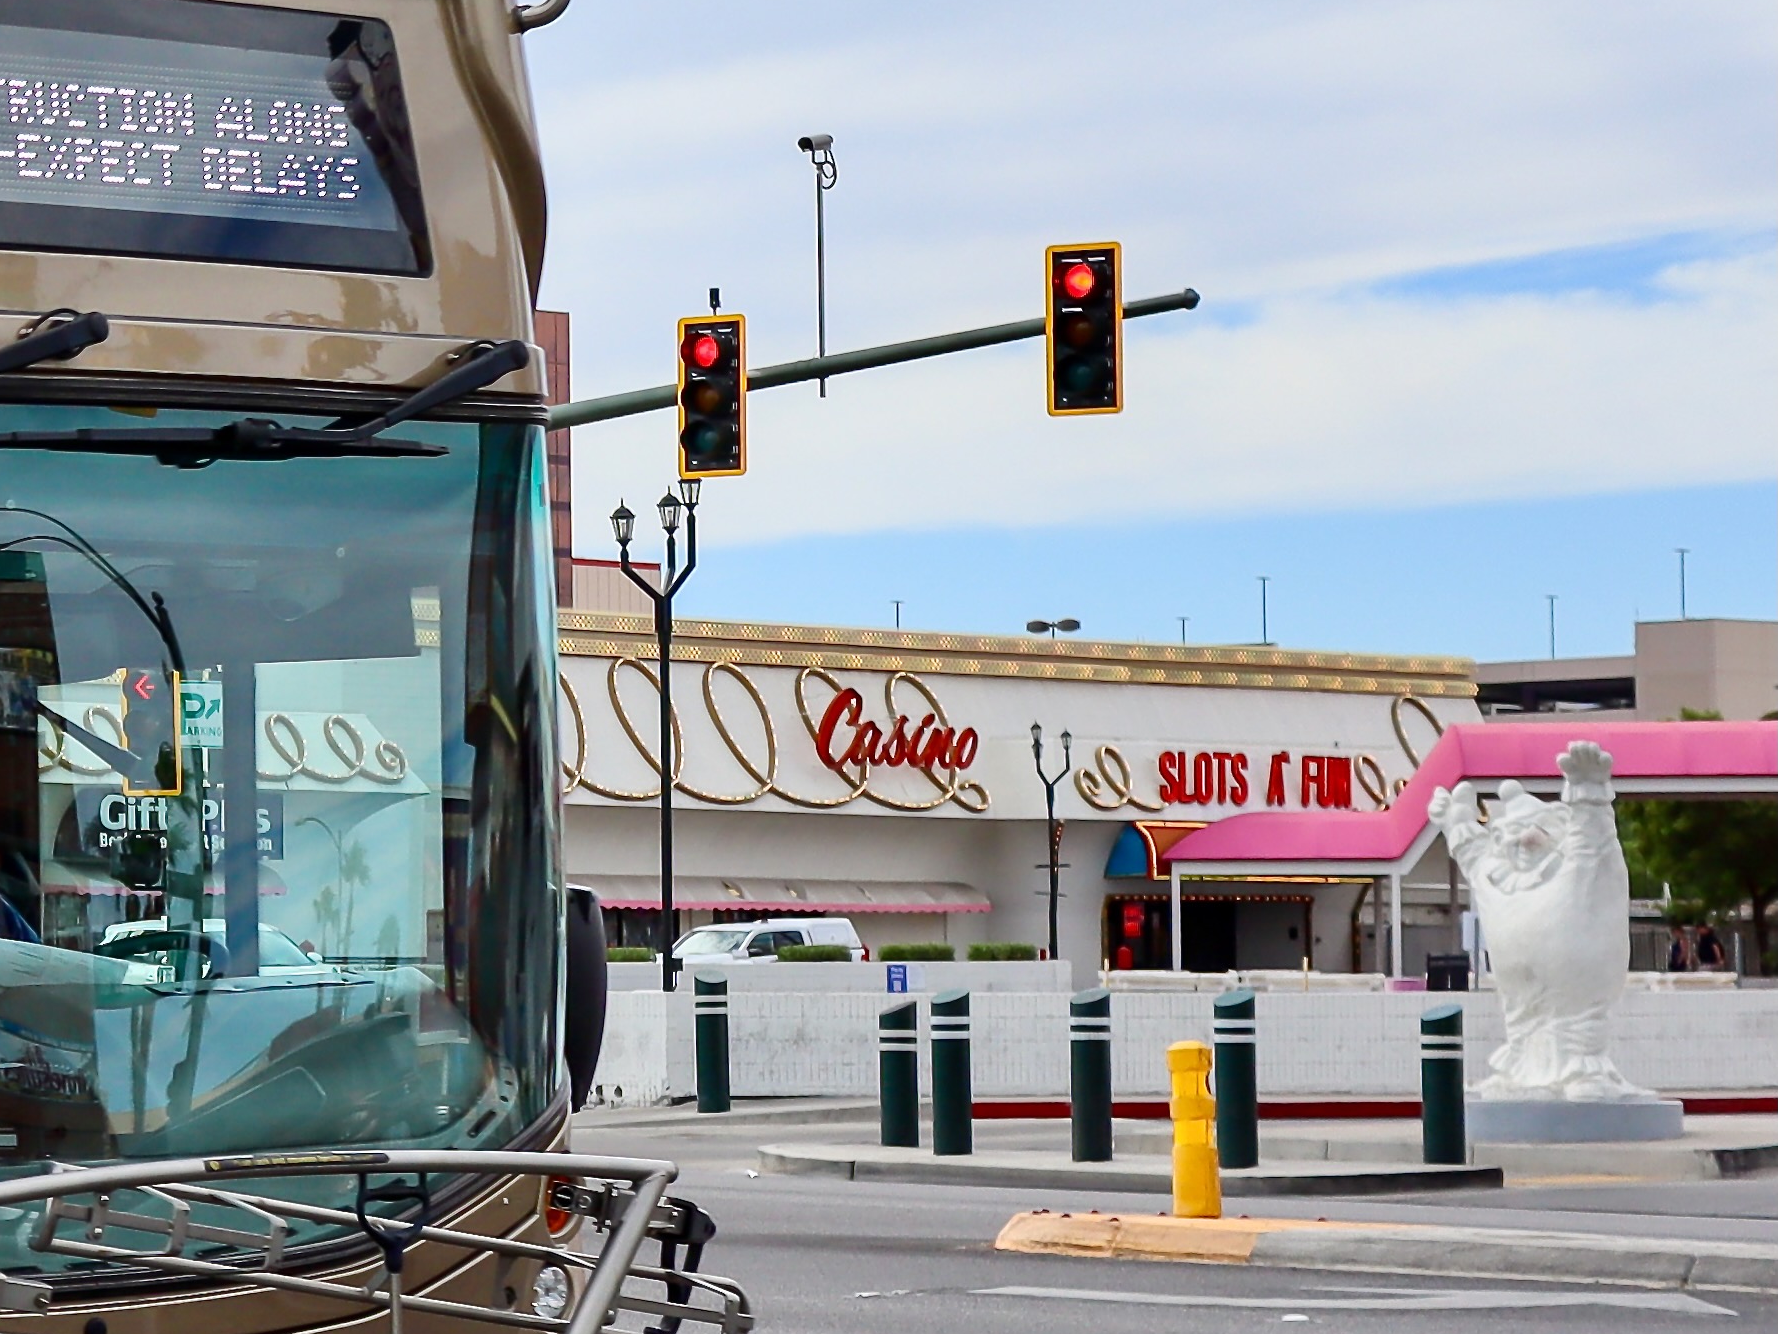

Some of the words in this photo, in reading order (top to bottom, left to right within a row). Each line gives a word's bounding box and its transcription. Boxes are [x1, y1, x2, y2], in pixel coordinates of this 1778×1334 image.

[215, 96, 349, 148] ALONG
[202, 147, 360, 199] DELAYS
[816, 687, 979, 771] Casino
[1158, 751, 1249, 805] SLOTS
[1301, 755, 1352, 808] FUN
